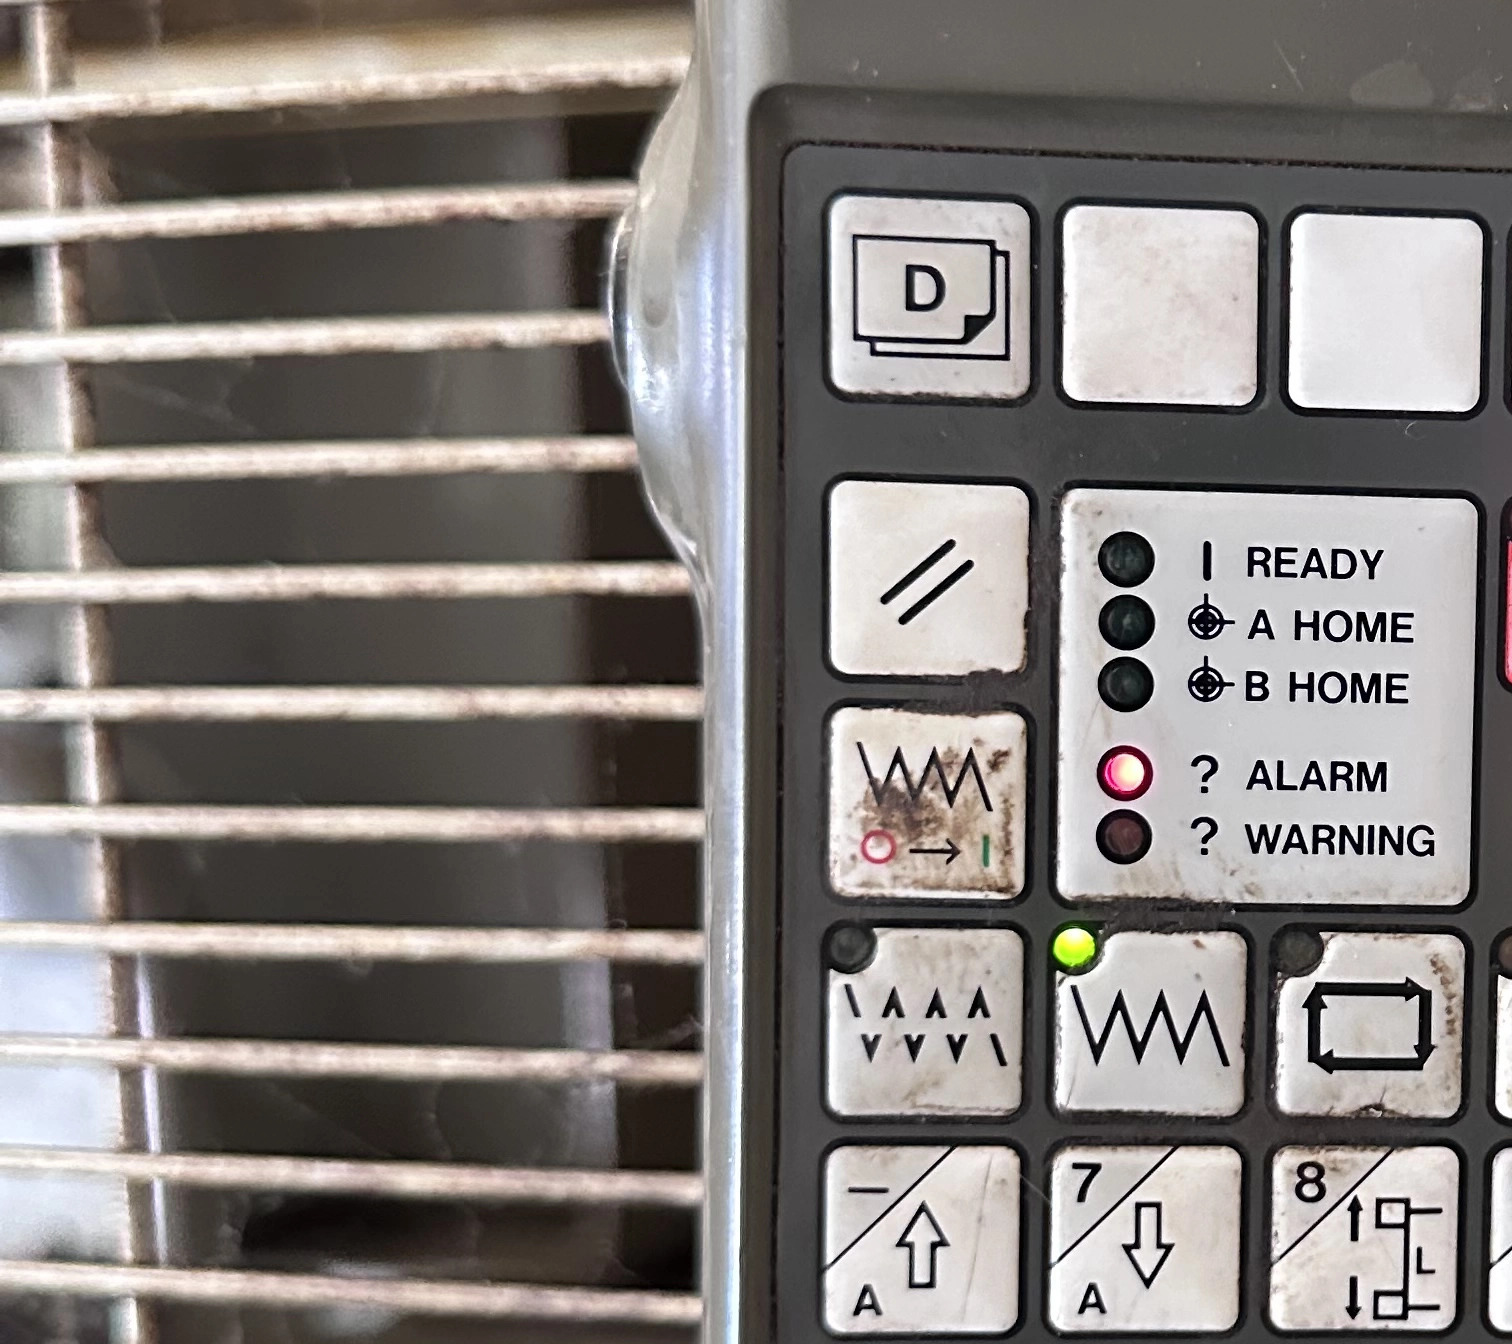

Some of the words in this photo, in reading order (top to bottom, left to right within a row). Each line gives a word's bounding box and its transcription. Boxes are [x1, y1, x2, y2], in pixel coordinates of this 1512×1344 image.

[905, 264, 946, 312] D
[1247, 546, 1384, 579] READY
[1248, 609, 1275, 640] A
[1294, 610, 1415, 643] HOME
[1245, 670, 1270, 702] B
[1289, 671, 1409, 704] HOME
[1246, 760, 1387, 792] ALARM
[1245, 824, 1436, 856] WARNING
[1072, 1162, 1102, 1203] 7
[1294, 1161, 1326, 1203] 8
[853, 1284, 882, 1316] A
[1077, 1282, 1107, 1315] A
